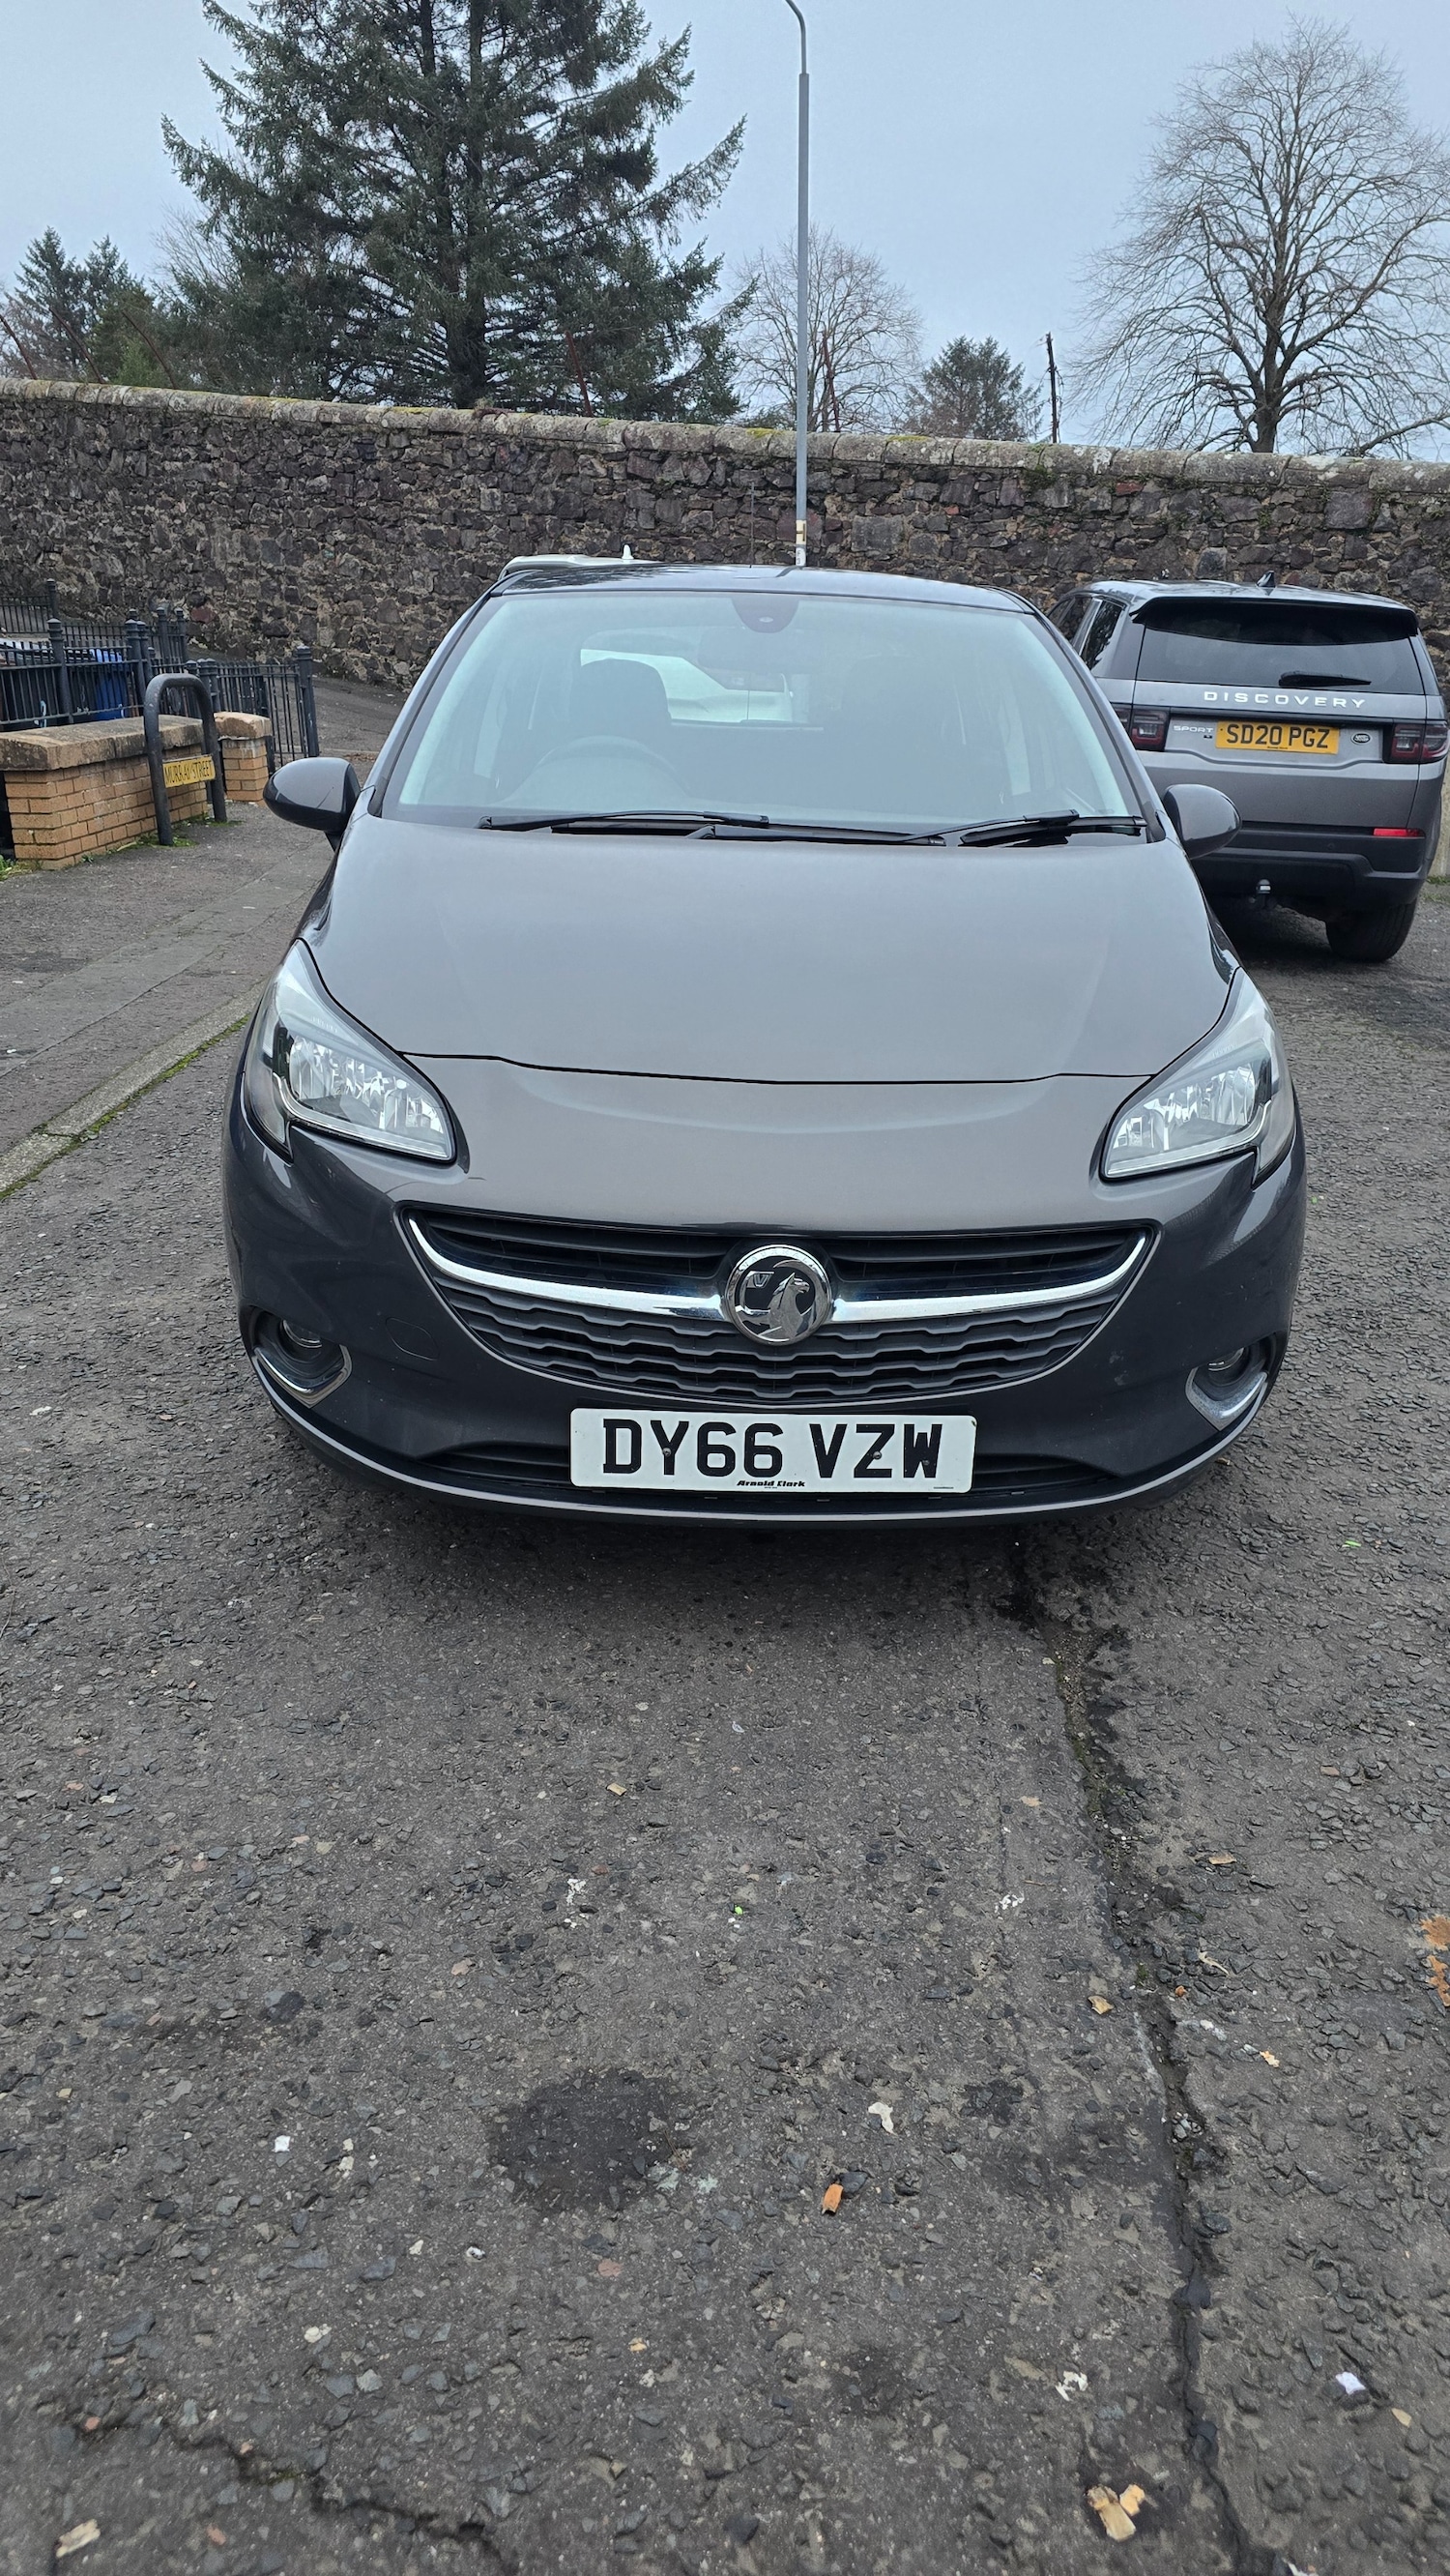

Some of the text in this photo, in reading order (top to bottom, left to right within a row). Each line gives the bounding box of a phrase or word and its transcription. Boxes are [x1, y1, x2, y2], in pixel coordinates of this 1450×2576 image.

[1204, 690, 1366, 709] DISCOVERY
[1226, 723, 1331, 748] SD20 PGZ
[164, 760, 213, 784] MURRAY STREET
[602, 1418, 942, 1478] DY66 VZW
